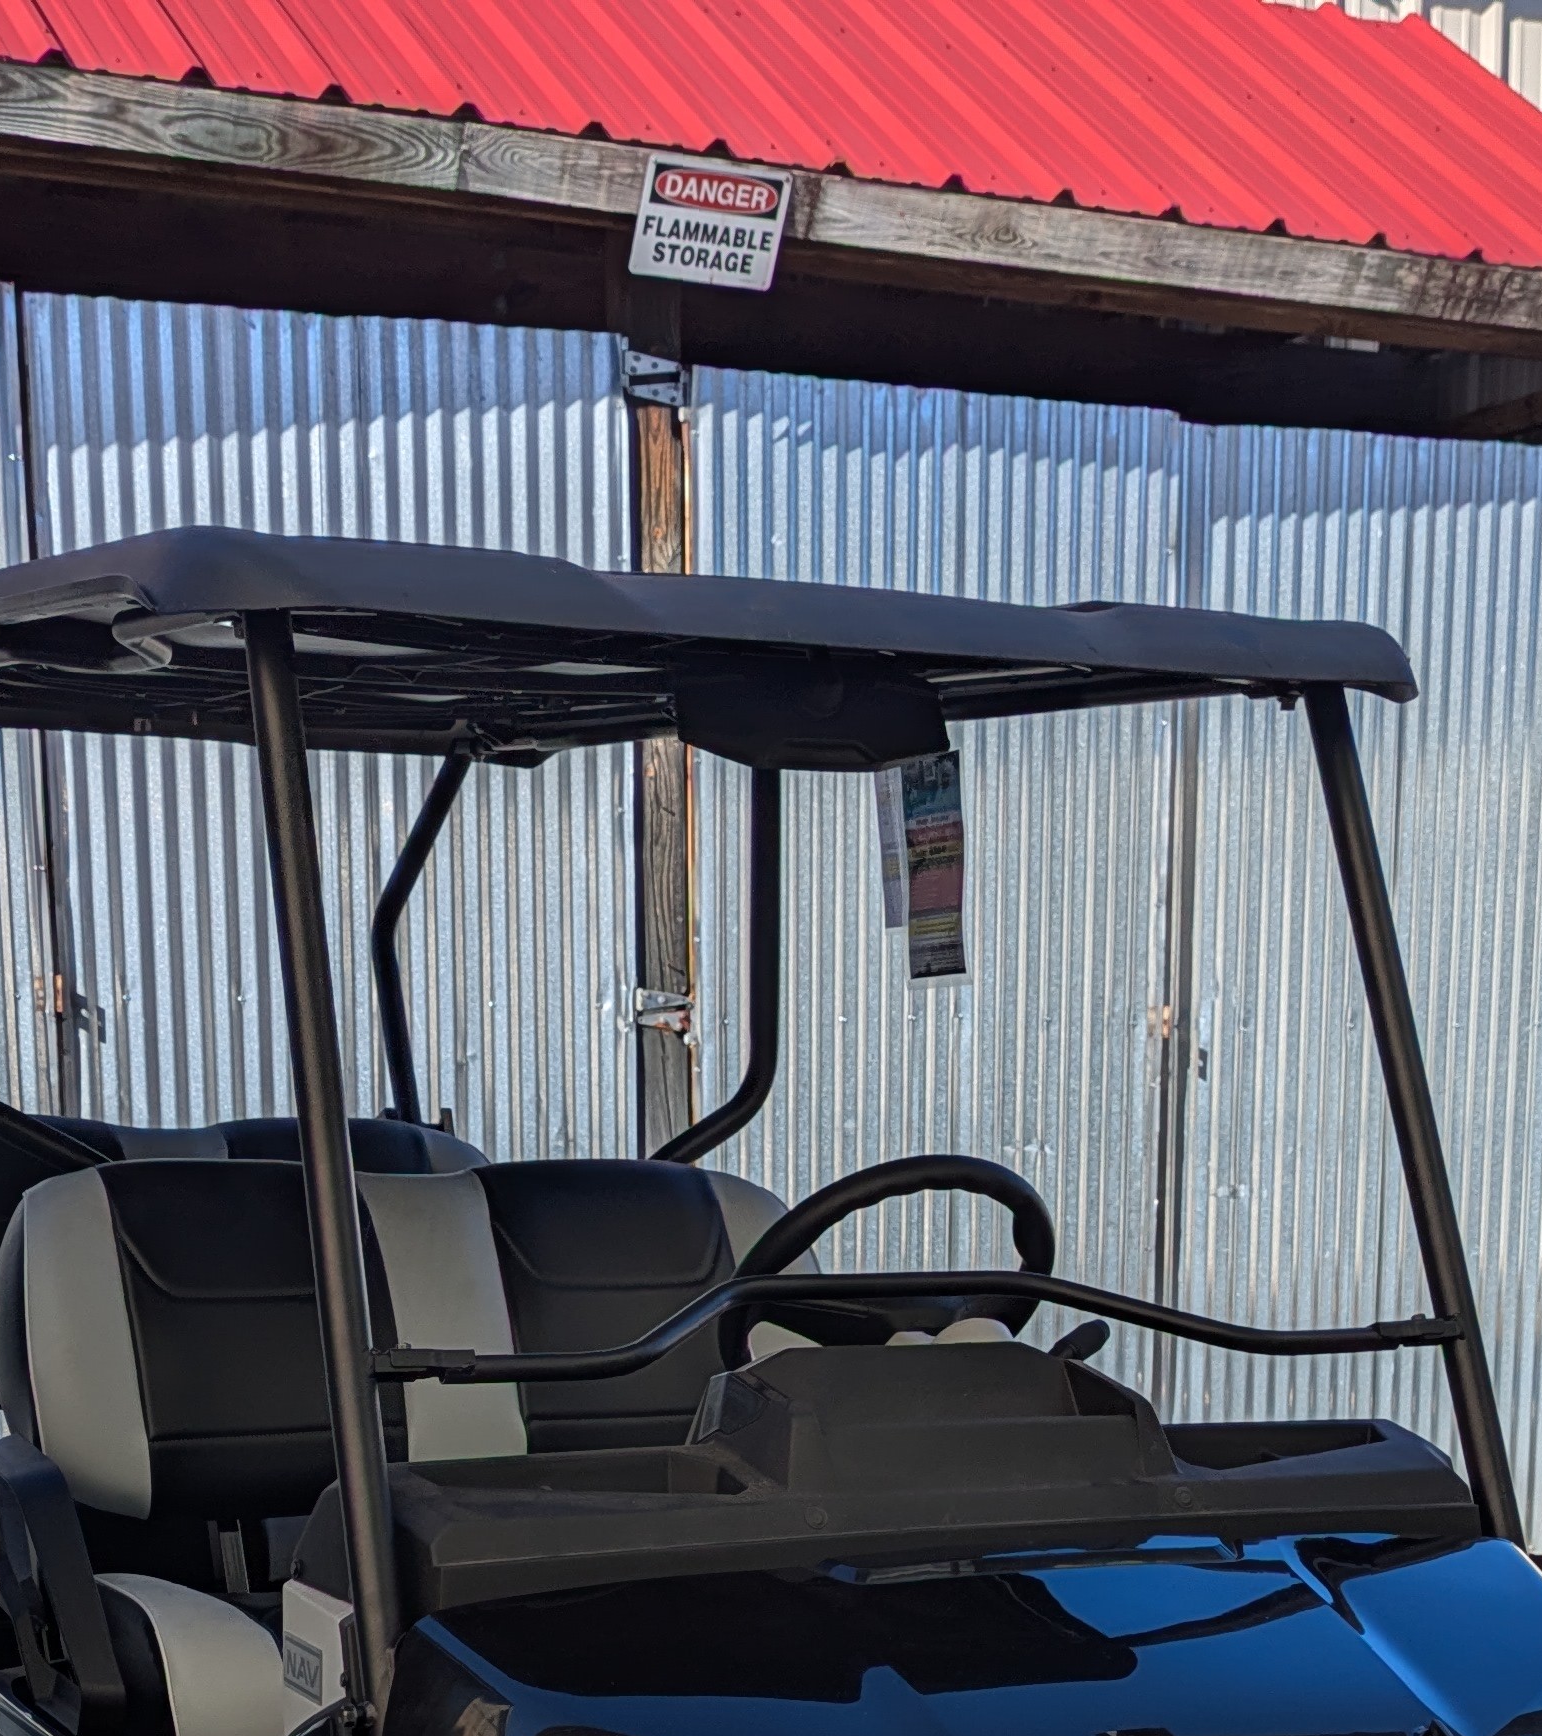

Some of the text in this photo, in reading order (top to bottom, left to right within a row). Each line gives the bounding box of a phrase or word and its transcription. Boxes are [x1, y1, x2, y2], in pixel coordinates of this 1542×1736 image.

[665, 177, 768, 209] DANGER
[642, 215, 774, 251] FLAMMABLE
[652, 242, 754, 275] STORAGE
[286, 1648, 319, 1688] NAV
